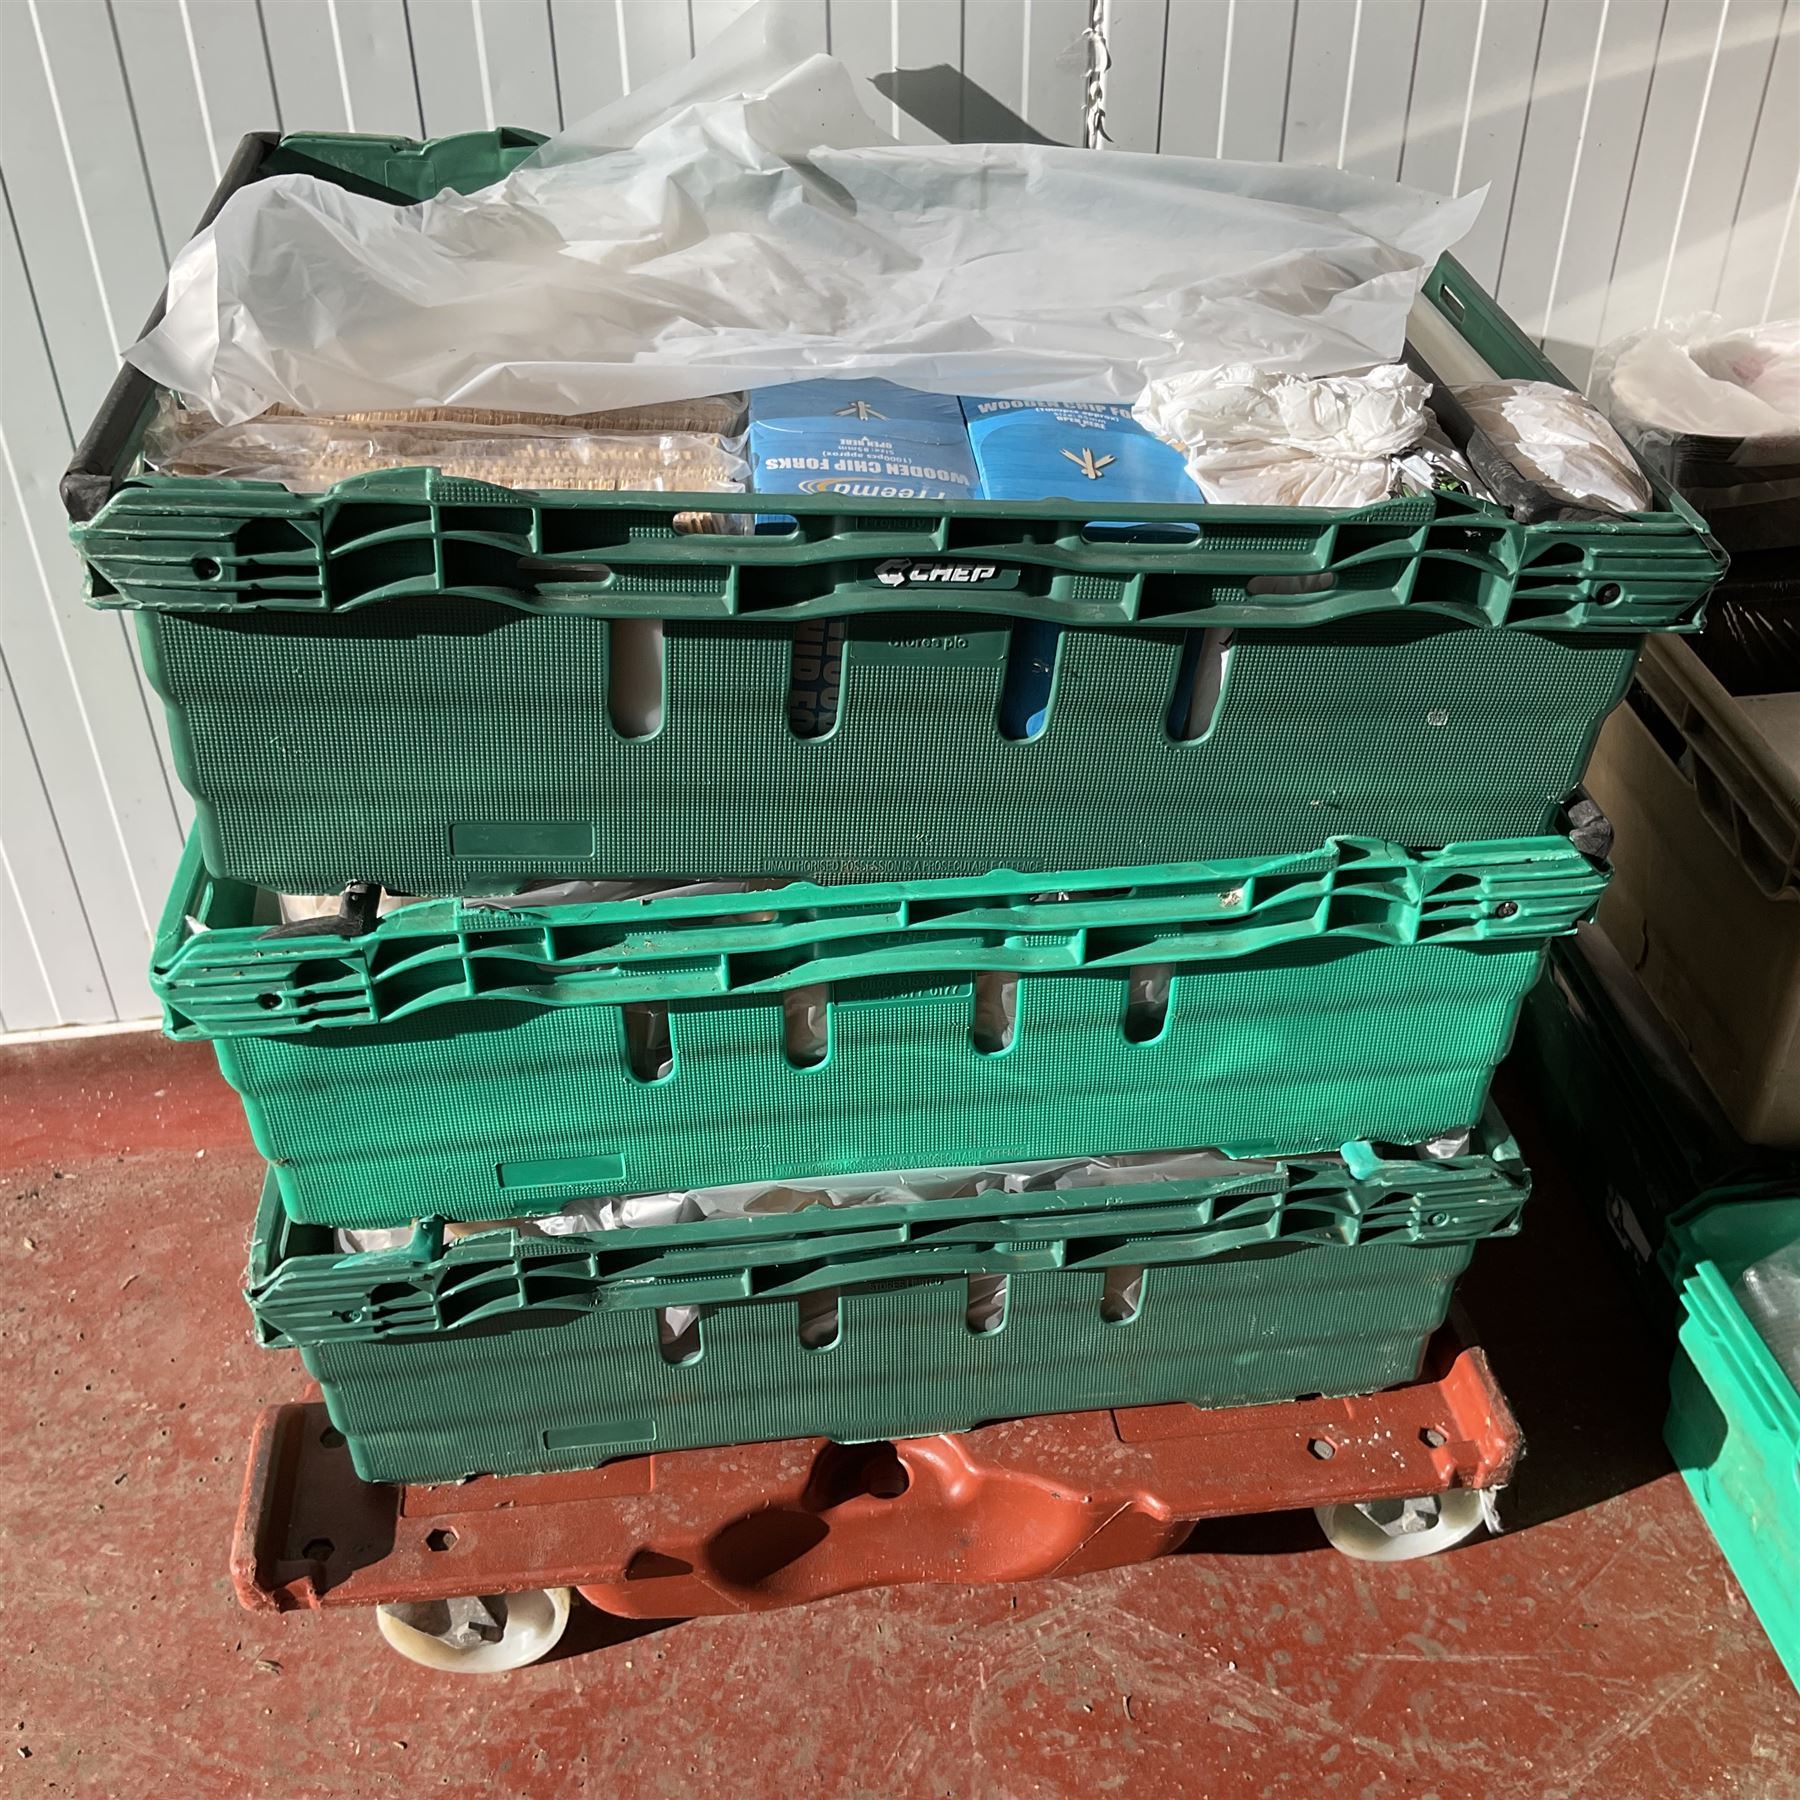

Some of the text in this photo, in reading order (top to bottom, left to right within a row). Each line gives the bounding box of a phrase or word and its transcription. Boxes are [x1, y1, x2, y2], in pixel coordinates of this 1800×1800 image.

[840, 438, 893, 449] OPEN HERE
[765, 458, 970, 486] WOODEN CHIP FORKS
[909, 563, 996, 582] CHEP
[763, 860, 839, 872] UNAUTHORISED
[840, 860, 901, 873] POSSESSION
[902, 860, 911, 872] IS
[922, 860, 995, 872] PROSECUTABLE
[775, 1162, 843, 1177] UNAUTHORISED
[844, 1157, 899, 1171] POSSESSION
[918, 1149, 984, 1165] PROSECUTABLE
[985, 1147, 1025, 1159] OFFENCE
